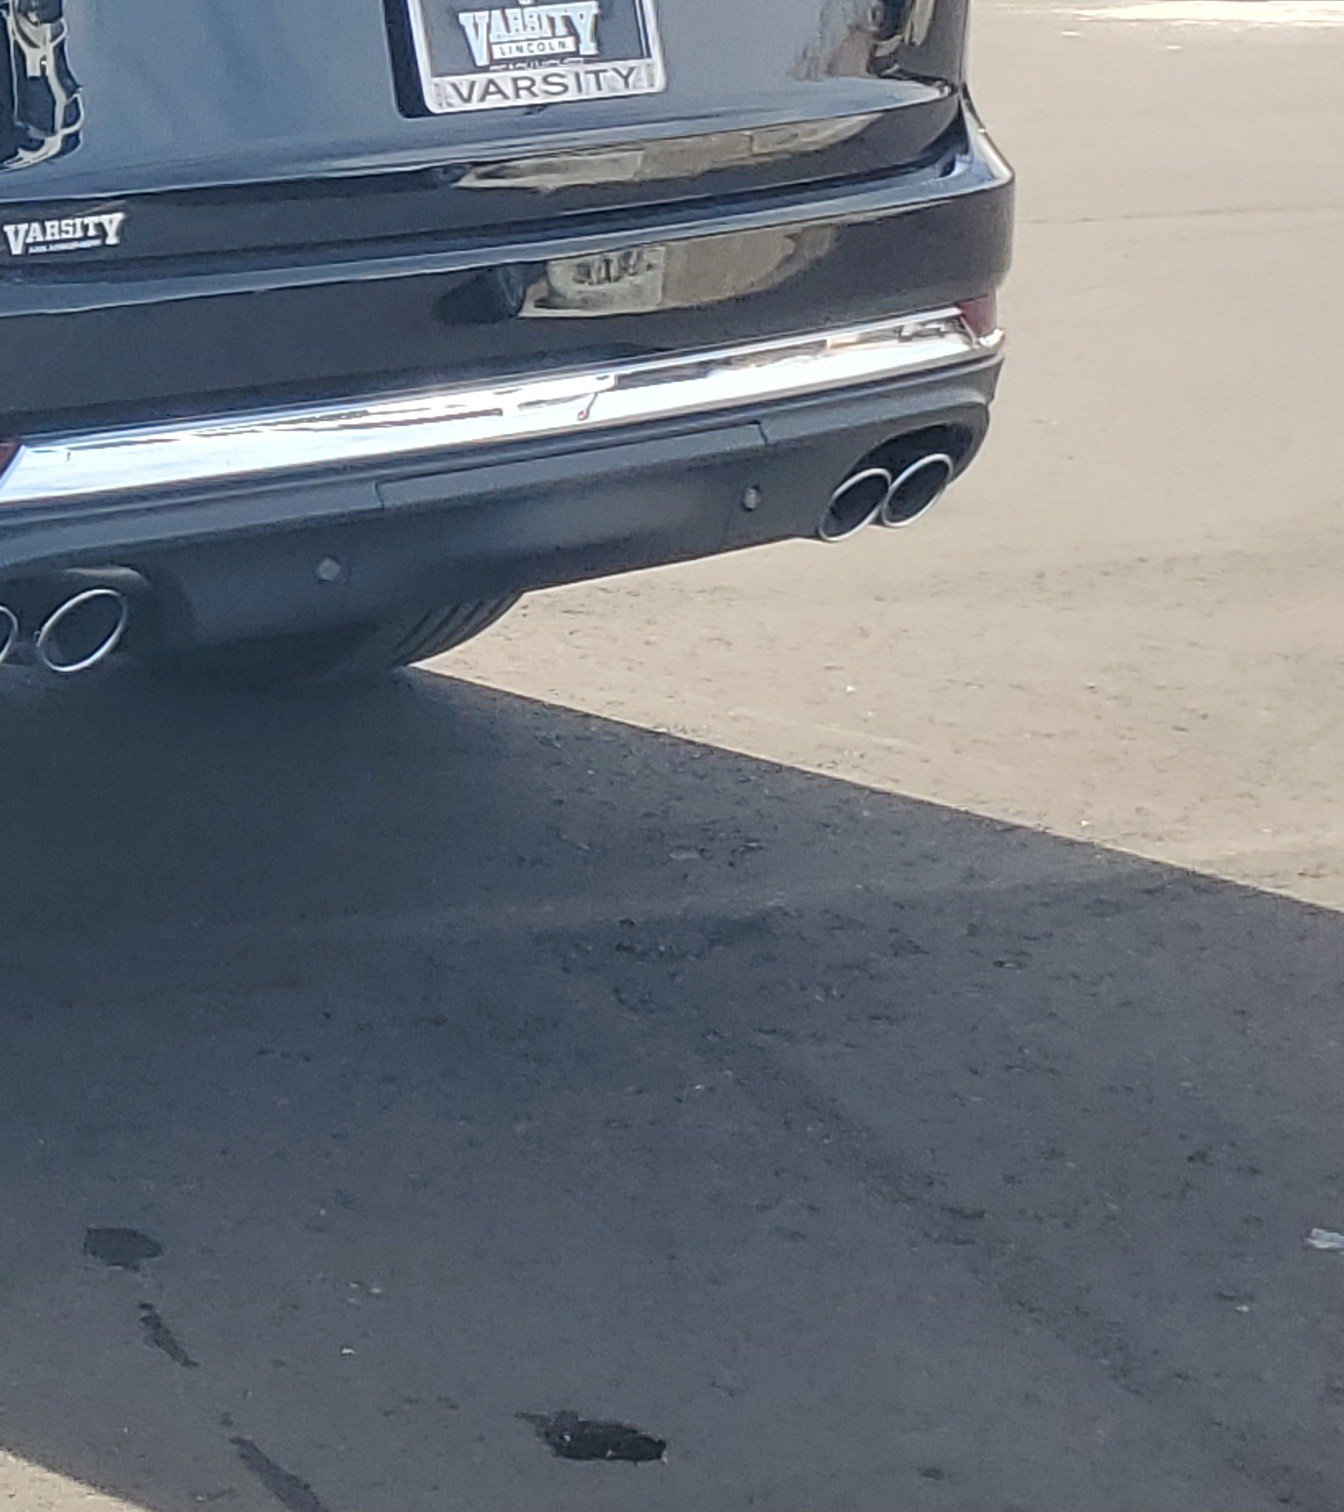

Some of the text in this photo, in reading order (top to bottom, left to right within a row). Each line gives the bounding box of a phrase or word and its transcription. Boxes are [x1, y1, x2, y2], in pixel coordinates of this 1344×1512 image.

[458, 1, 599, 66] VARSITY
[498, 40, 568, 57] LINCOLN
[451, 67, 636, 104] VARSITY
[3, 212, 126, 255] VARSITY
